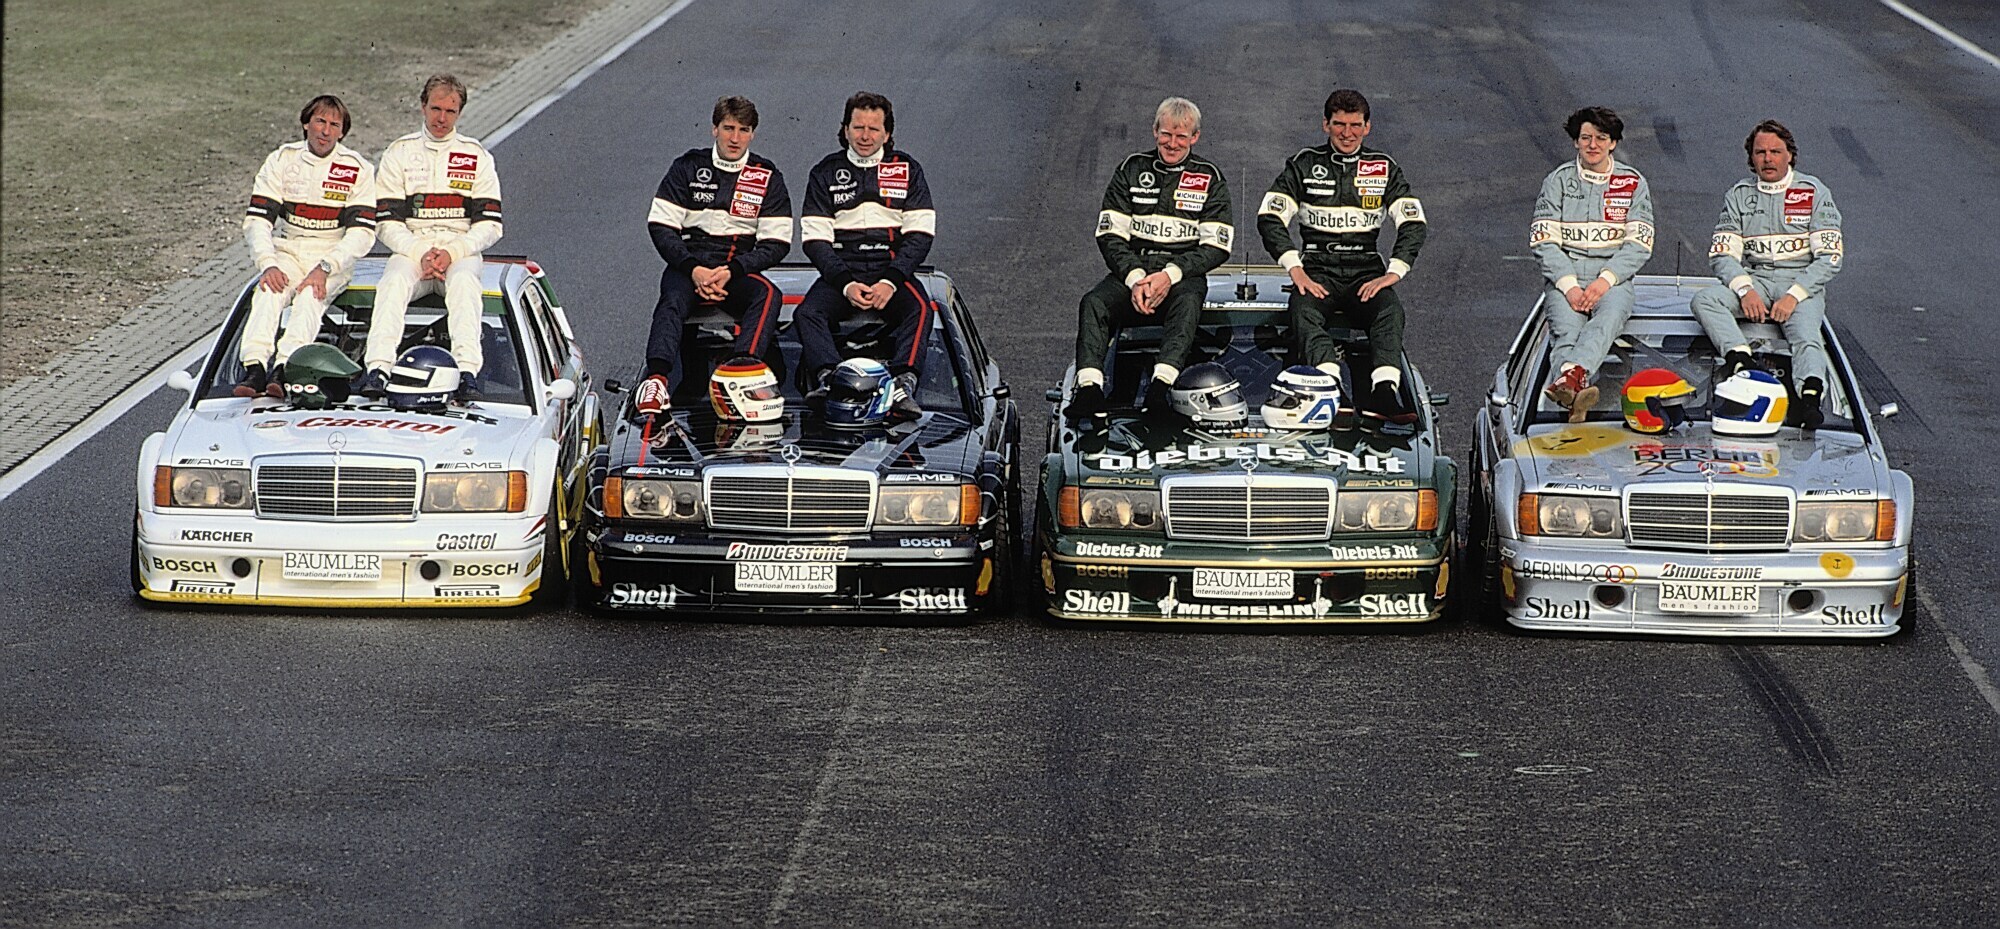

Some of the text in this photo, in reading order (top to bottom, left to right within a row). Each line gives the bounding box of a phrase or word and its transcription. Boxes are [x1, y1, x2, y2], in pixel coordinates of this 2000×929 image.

[1176, 192, 1205, 201] MICHELIN
[1561, 227, 1589, 241] ERLIN
[297, 417, 457, 434] Castrol
[181, 530, 253, 543] KÄRCHER
[436, 532, 498, 551] Castrol
[623, 534, 676, 544] BOSCH
[899, 538, 952, 547] BOSCH
[728, 543, 846, 560] BRIDGESTONE
[153, 556, 217, 573] BOSCH
[285, 552, 380, 570] BÄUMLER
[1522, 559, 1578, 579] BERLIN
[284, 570, 329, 578] international
[330, 571, 352, 579] men's
[453, 562, 519, 577] BOSCH
[737, 562, 834, 581] BÄUMLER
[1076, 565, 1129, 579] BOSCH
[1364, 567, 1418, 580] BOSCH
[1661, 564, 1763, 579] BRIDGESTONE
[737, 581, 783, 589] international
[1195, 570, 1291, 587] BÄUMLER
[170, 579, 235, 595] PIRELLI
[434, 584, 500, 597] PIRELLI
[609, 583, 676, 606] Shell
[1195, 588, 1291, 597] international men's fashion
[1661, 583, 1757, 601] BÄUMLER
[899, 587, 968, 610] Shell
[1063, 589, 1130, 614] Shell
[1360, 592, 1429, 616] Shell
[1177, 602, 1314, 616] MICHELIN
[1525, 596, 1590, 620] Shell
[1821, 603, 1885, 626] Shell
